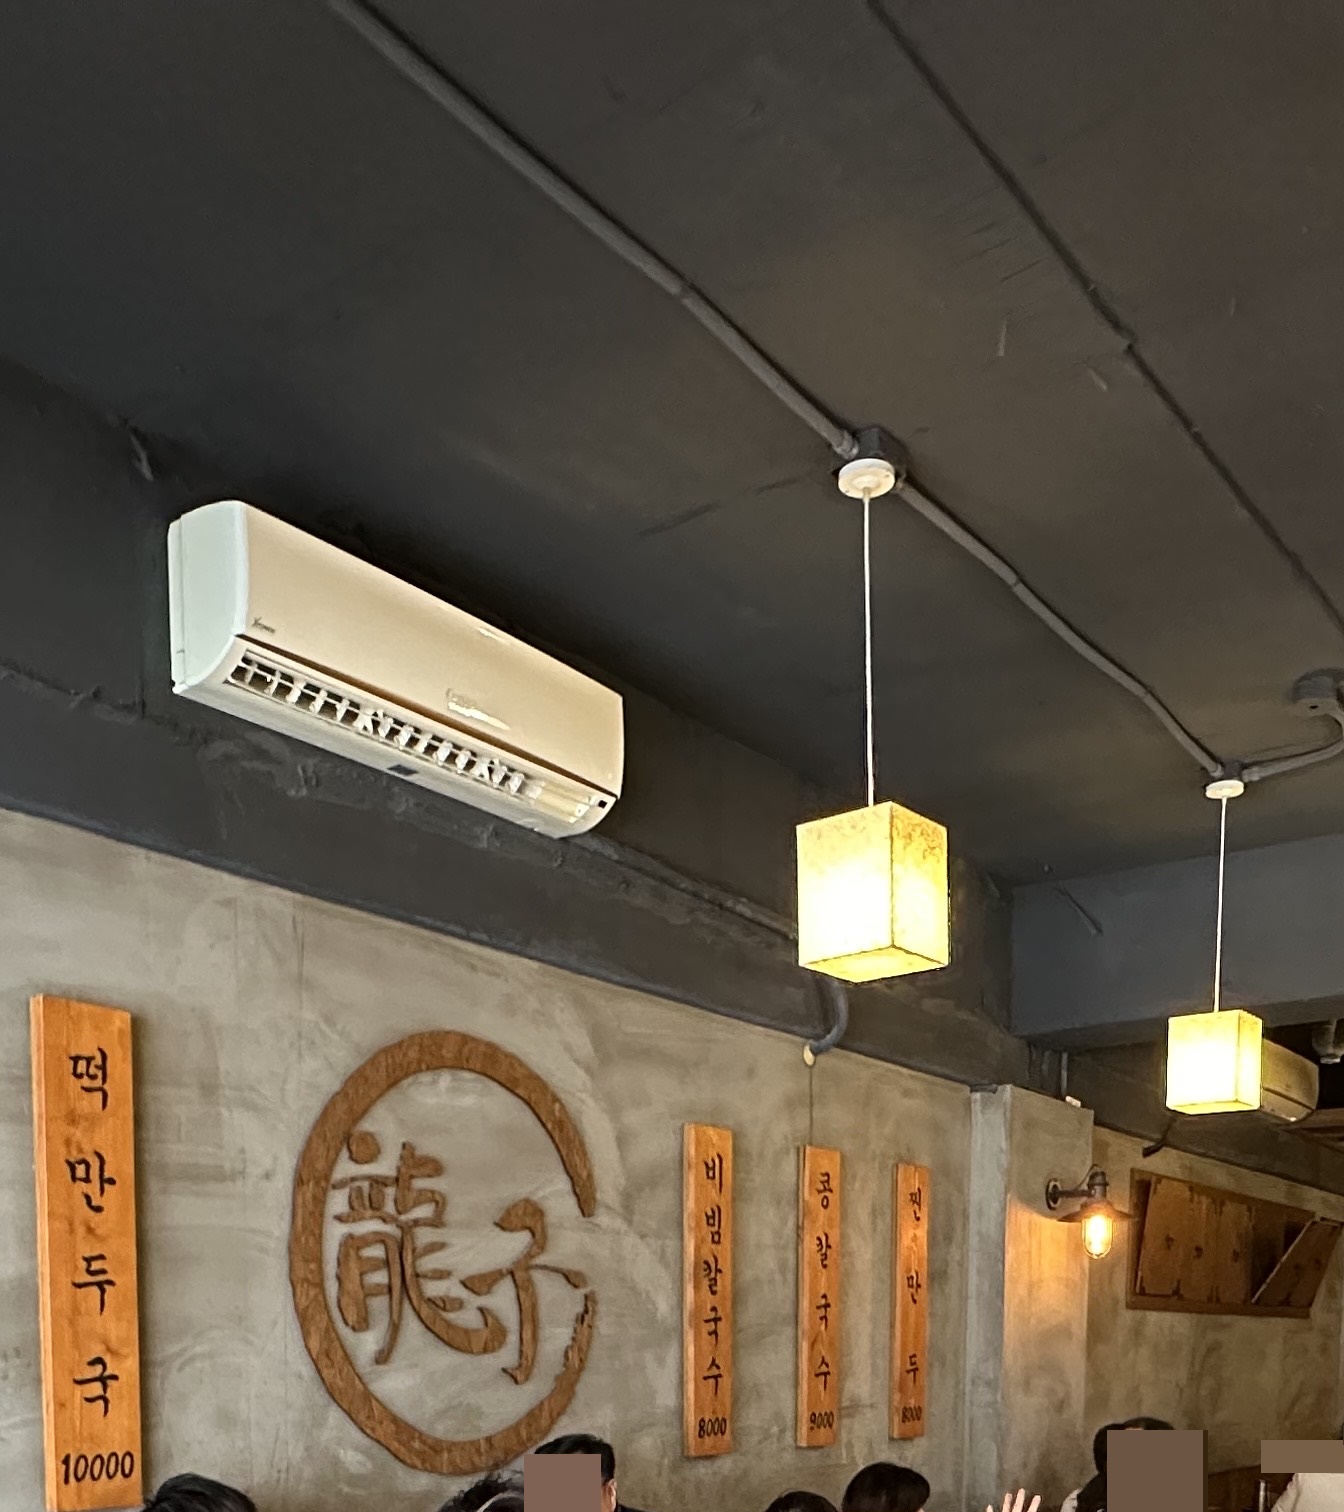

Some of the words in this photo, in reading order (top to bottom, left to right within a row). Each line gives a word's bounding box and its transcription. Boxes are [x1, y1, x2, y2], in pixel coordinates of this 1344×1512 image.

[64, 1046, 120, 1418] 떡만두국
[702, 1152, 724, 1398] 비빔칼국수
[813, 1171, 834, 1393] 콩칼국수
[904, 1186, 923, 1387] 찐만두
[60, 1450, 135, 1486] 10000
[697, 1417, 728, 1439] 8000
[809, 1410, 835, 1432] 9000
